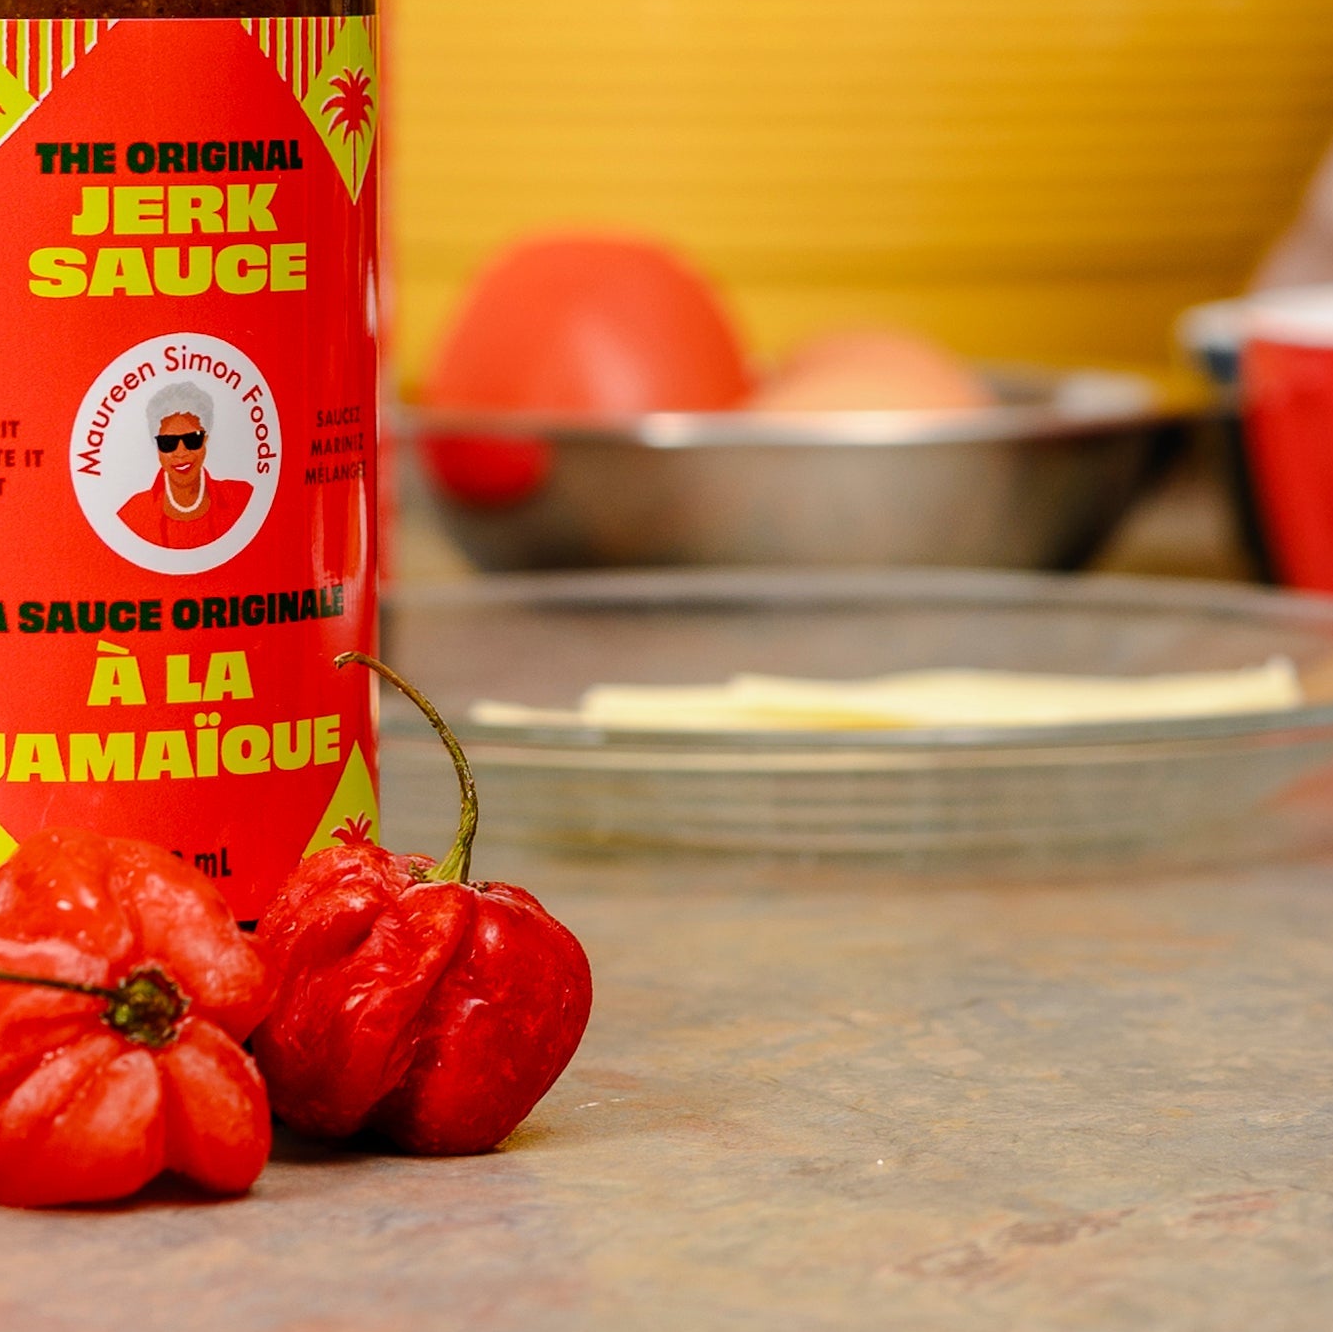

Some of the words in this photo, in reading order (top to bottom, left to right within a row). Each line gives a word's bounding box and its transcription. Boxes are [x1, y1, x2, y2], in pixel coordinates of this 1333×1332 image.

[35, 142, 116, 174] THE
[126, 140, 303, 173] ORIGINAL
[71, 183, 279, 236] JERK
[28, 242, 307, 298] SAUCE
[1, 420, 20, 438] IT
[77, 361, 156, 476] Maureen
[164, 345, 242, 390] Simon
[242, 384, 277, 475] Foods
[316, 406, 361, 428] SAUCEZ
[24, 449, 44, 468] IT
[18, 600, 162, 634] SAUCE
[172, 585, 344, 630] ORIGINALE
[86, 639, 148, 706] À
[166, 650, 255, 704] LA
